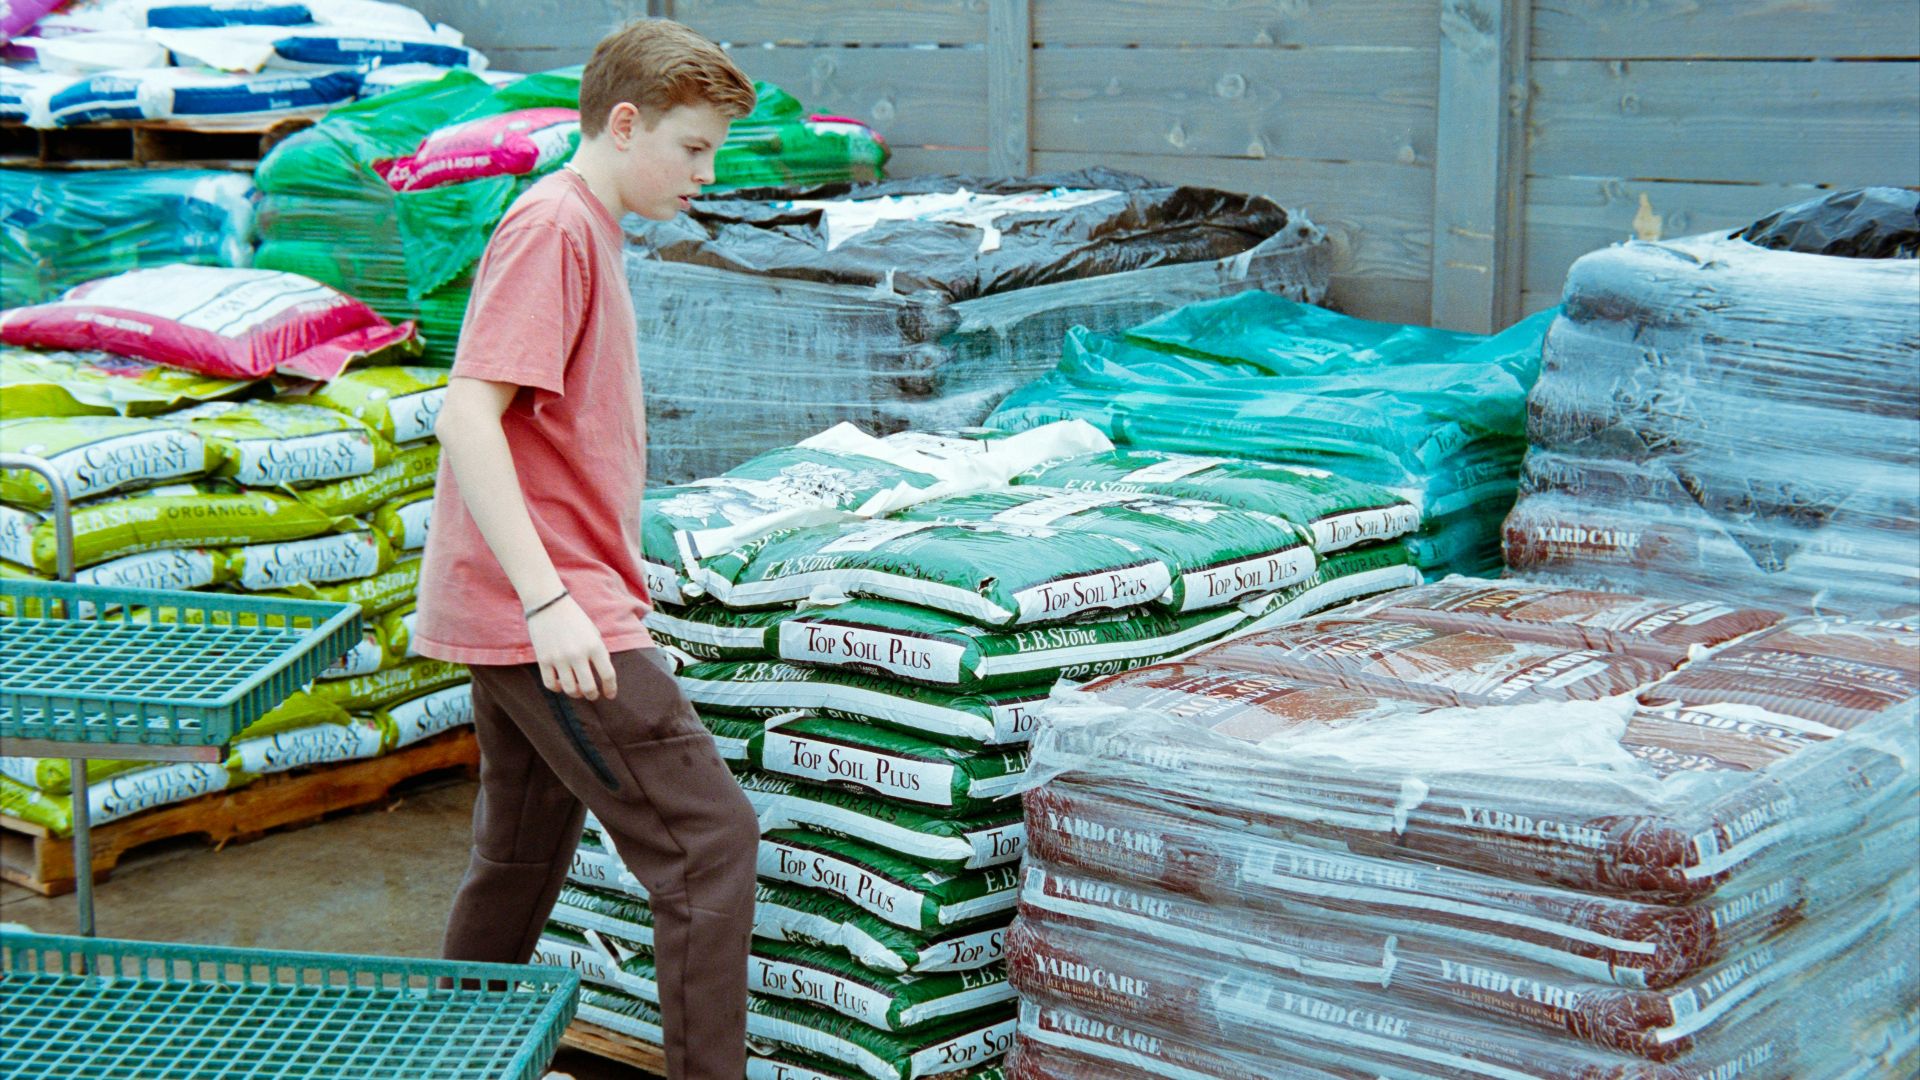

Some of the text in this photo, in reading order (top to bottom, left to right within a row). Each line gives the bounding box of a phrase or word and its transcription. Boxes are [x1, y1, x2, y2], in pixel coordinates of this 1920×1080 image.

[84, 434, 188, 470] CACTUS &
[268, 438, 355, 464] CACTUS &
[75, 453, 188, 492] SUCCULENT
[256, 454, 356, 481] SUCCULENT
[167, 504, 258, 519] ORGANICS
[1327, 520, 1352, 543] TOP
[1355, 515, 1380, 539] SOIL
[174, 548, 191, 568] &
[273, 539, 360, 567] CACTUS &
[262, 558, 360, 585] SUCCULENT
[647, 574, 665, 593] US
[1204, 559, 1297, 597] TOP SOIL PLUS
[1038, 587, 1070, 613] TOP
[1073, 582, 1108, 607] SOIL
[681, 640, 721, 659] PLUS
[804, 626, 932, 670] TOP SOIL PLUS
[1014, 627, 1097, 652] E.B.Stone
[732, 663, 815, 682] E.B.Stone
[1059, 664, 1090, 680] TOP
[1093, 661, 1122, 675] SOIL
[1009, 707, 1038, 733] TO
[789, 740, 920, 791] TOP SOIL PLUS
[987, 831, 1020, 858] TOP
[571, 853, 605, 881] PLUS
[775, 847, 896, 913] TOP SOIL PLUS
[1054, 875, 1172, 920] YARDCARE
[570, 950, 606, 980] PLUS
[948, 940, 984, 964] TOP
[758, 961, 869, 1016] TOP SOIL PLUS
[1035, 952, 1149, 999] YARDCARE
[1440, 958, 1583, 1013] YARDCARE
[939, 1030, 1013, 1064] TOP SOI
